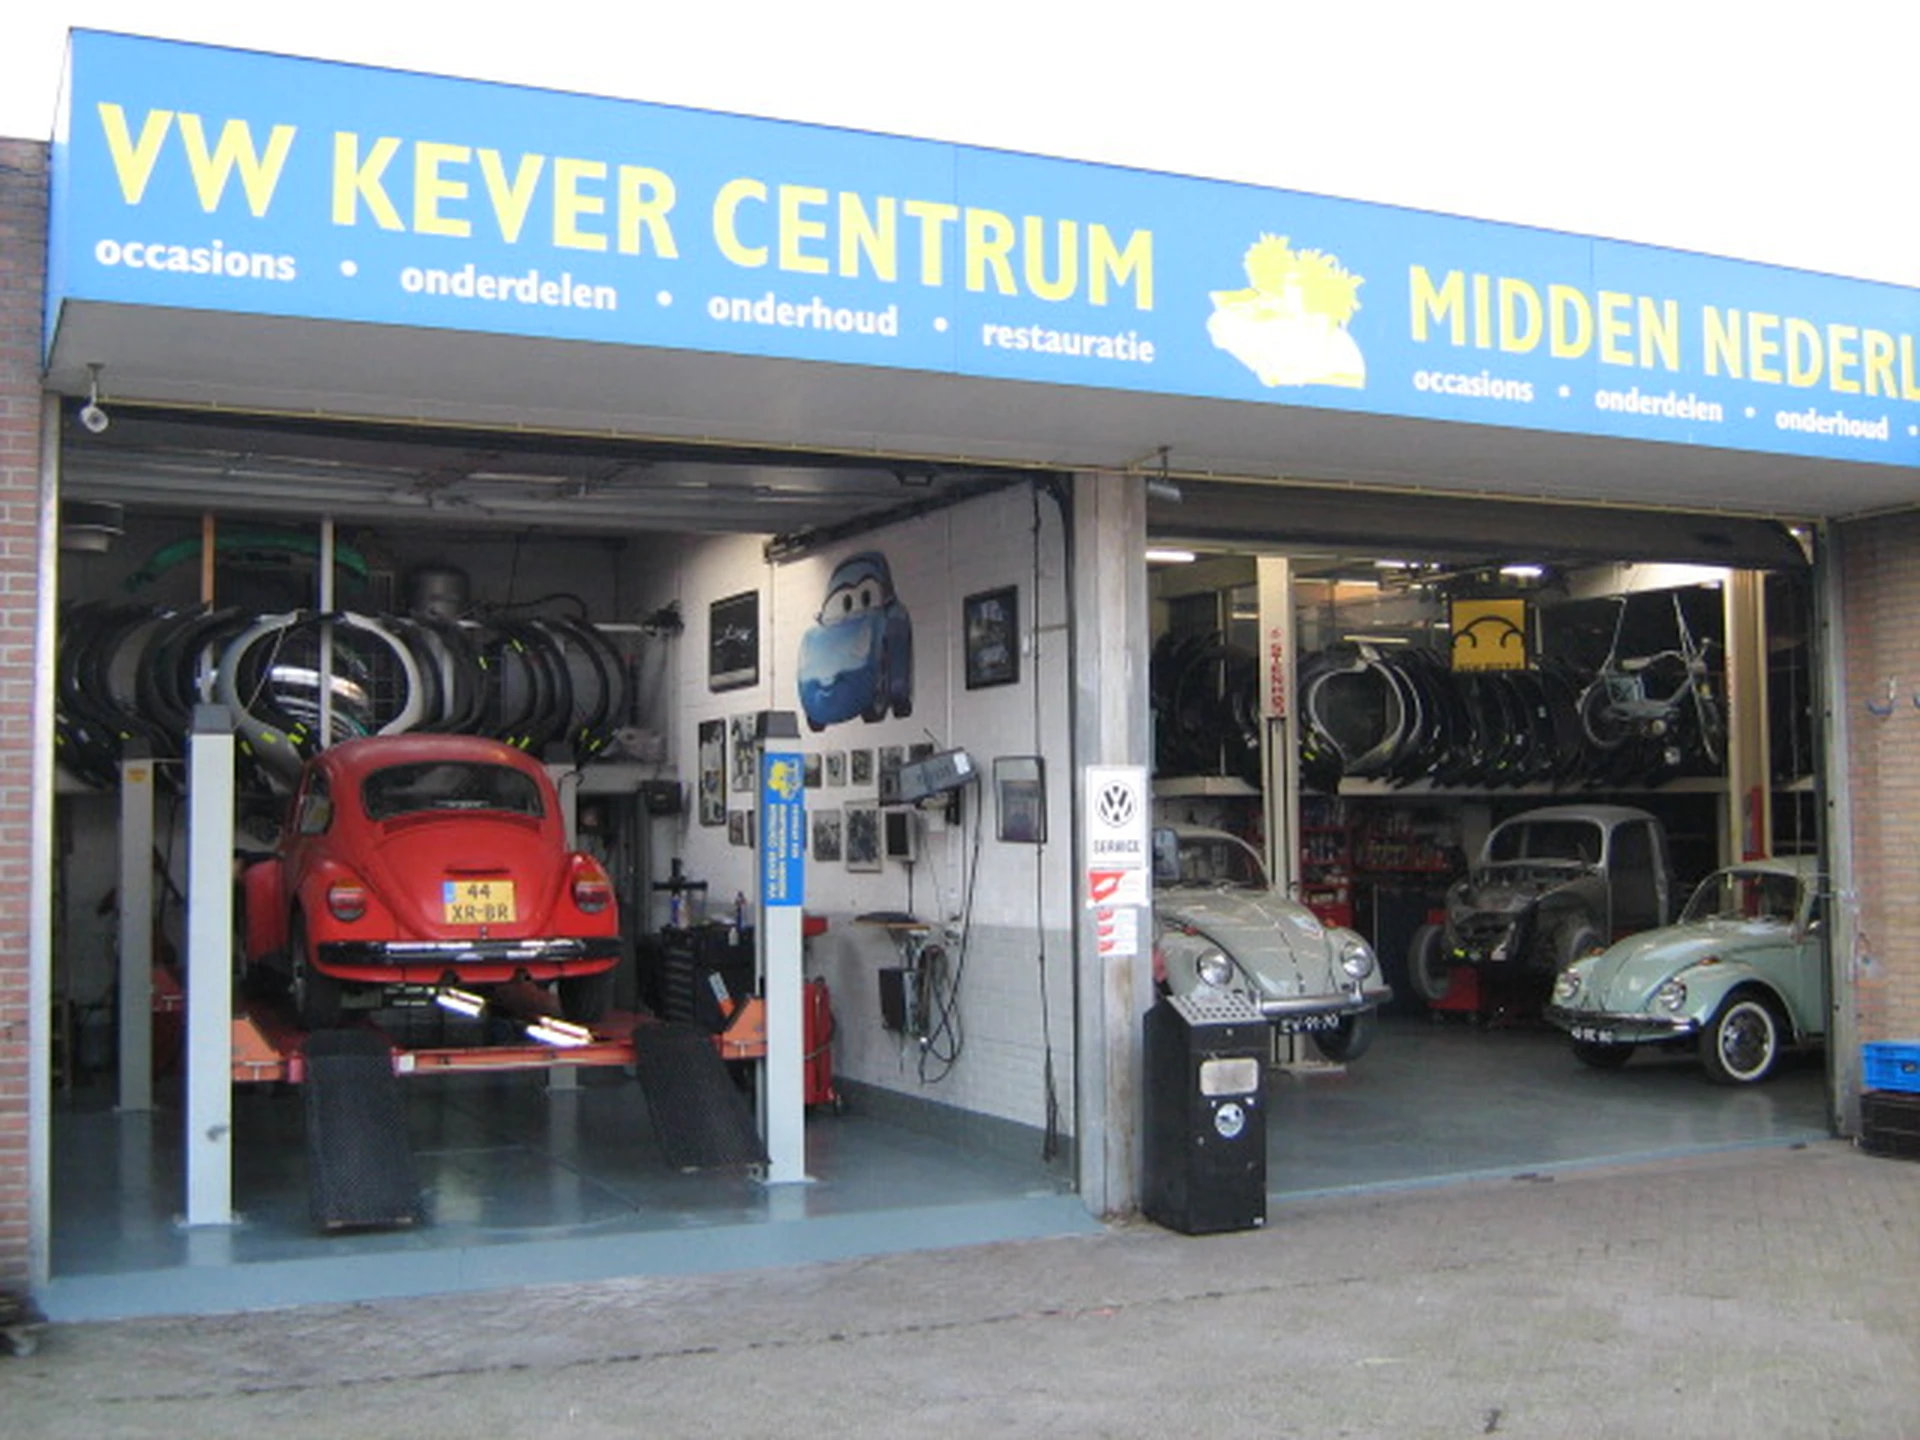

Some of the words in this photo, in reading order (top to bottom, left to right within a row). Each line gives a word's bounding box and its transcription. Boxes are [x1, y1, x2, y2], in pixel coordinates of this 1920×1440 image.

[98, 102, 297, 218] VW
[331, 131, 679, 260] KEVER
[712, 177, 1154, 311] CENTRUM
[95, 238, 297, 282] occasions
[400, 262, 618, 311] onderdelen
[707, 289, 898, 337] onderhoud
[982, 320, 1155, 364] restauratie
[1409, 264, 1681, 372] MIDDEN
[1702, 304, 1920, 402] NEDERL
[1412, 367, 1534, 402] occasions
[1594, 387, 1724, 422] onderdelen
[1775, 407, 1889, 441] onderhoud
[467, 884, 491, 899] 44
